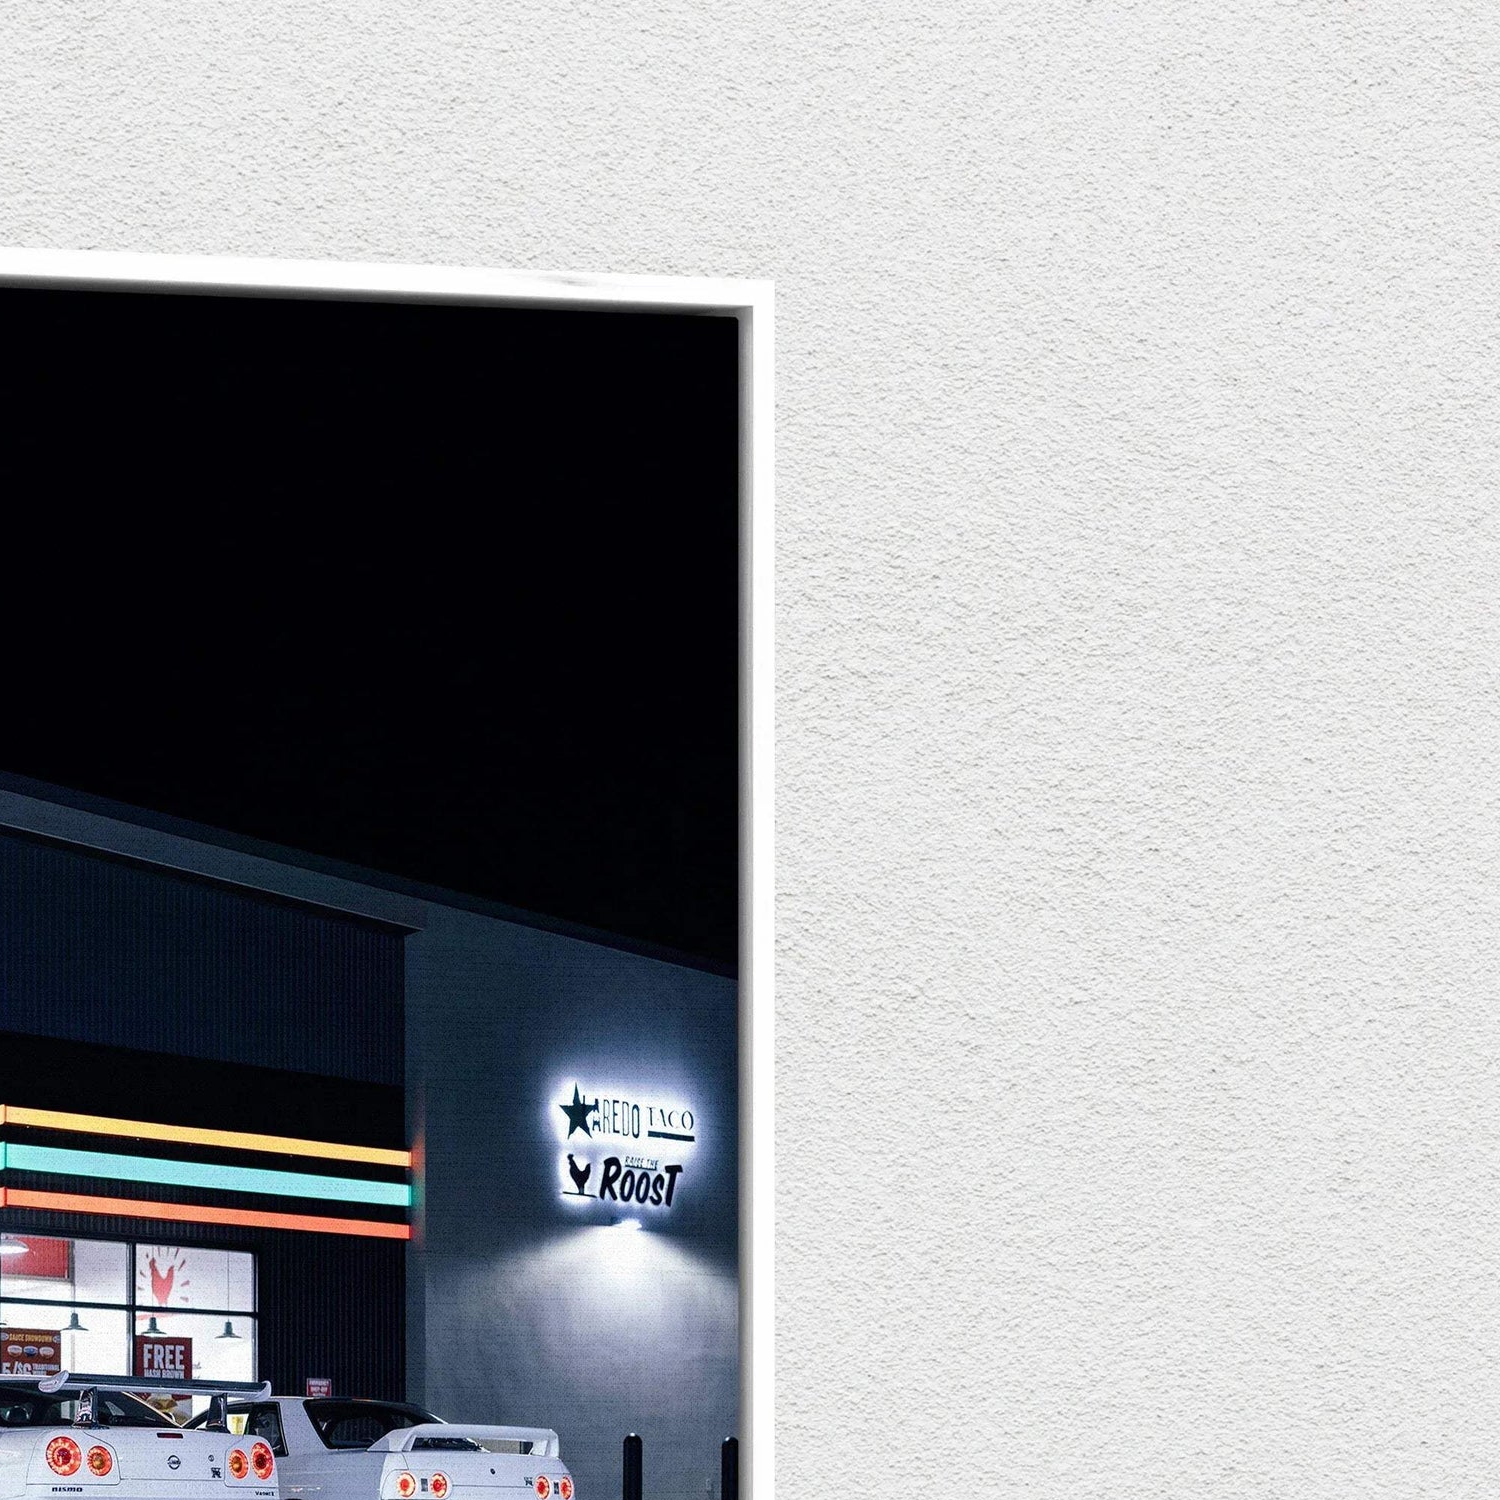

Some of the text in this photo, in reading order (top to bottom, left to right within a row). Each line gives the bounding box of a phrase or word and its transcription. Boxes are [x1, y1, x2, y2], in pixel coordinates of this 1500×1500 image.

[647, 1106, 694, 1130] TACO
[647, 1159, 658, 1168] THE
[599, 1156, 683, 1207] ROOST
[143, 1344, 185, 1370] FREE
